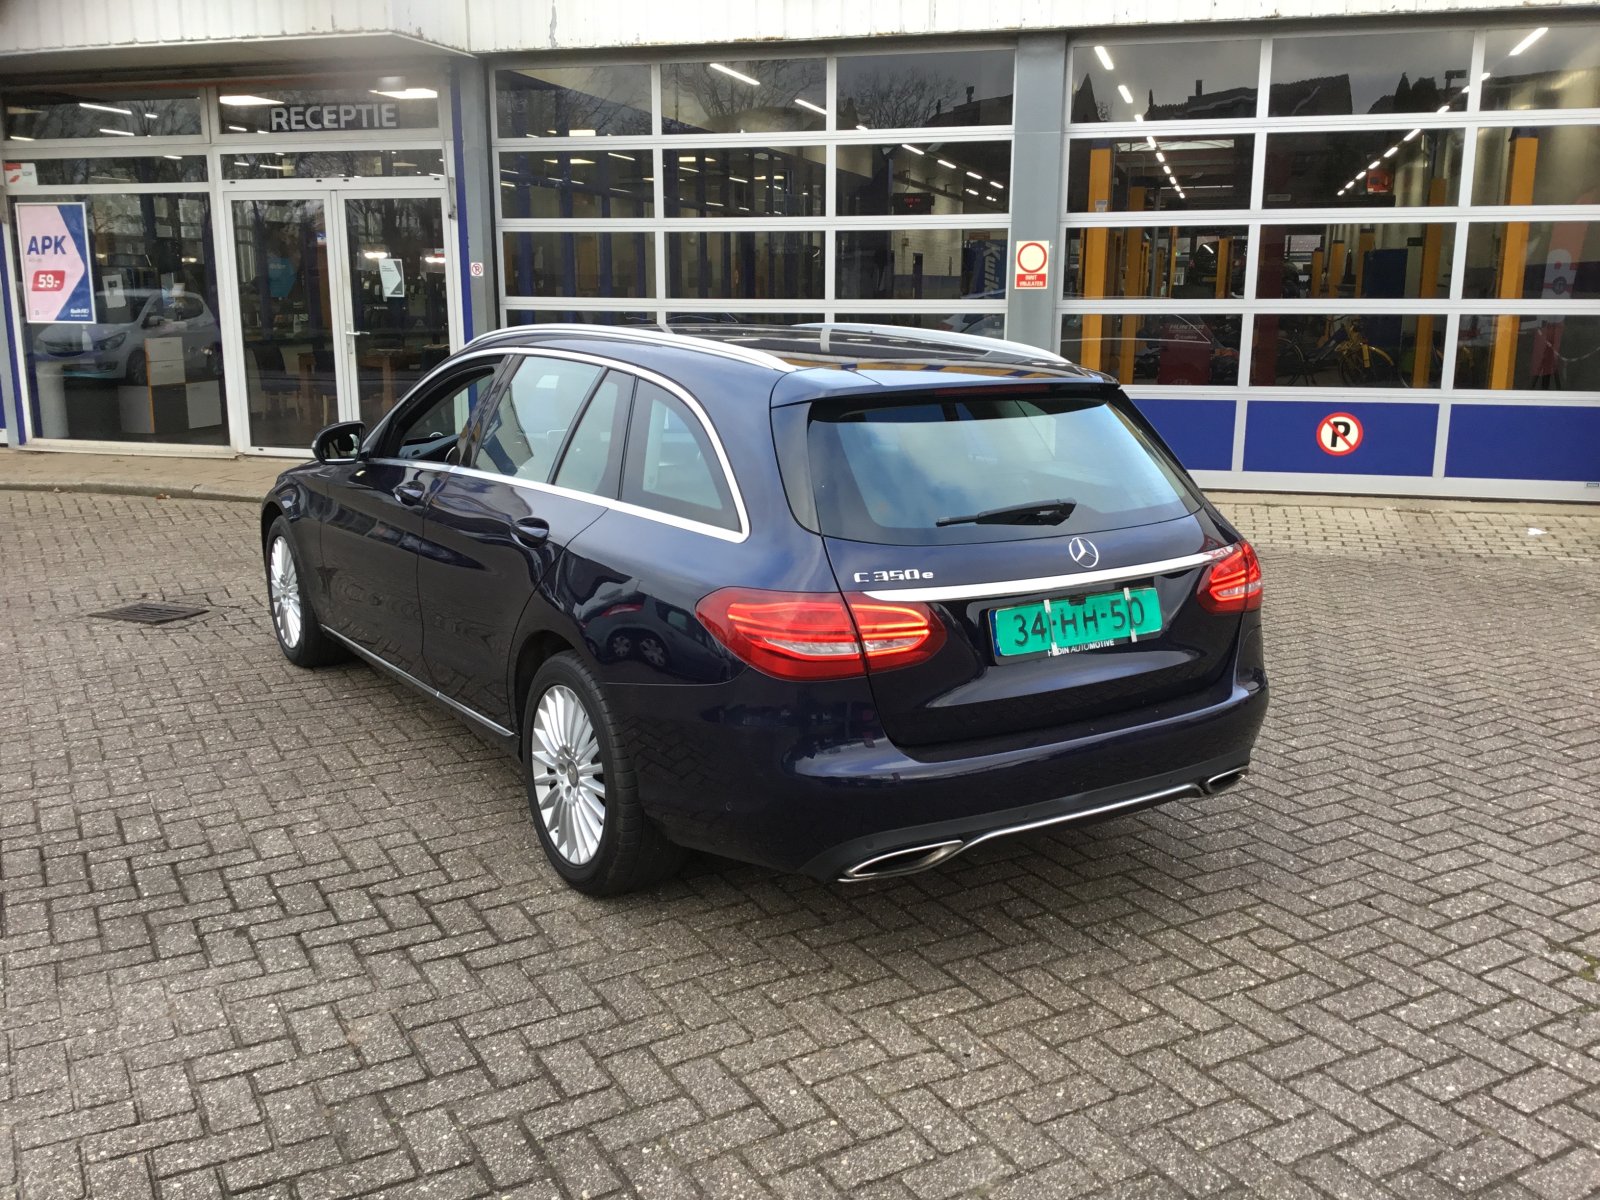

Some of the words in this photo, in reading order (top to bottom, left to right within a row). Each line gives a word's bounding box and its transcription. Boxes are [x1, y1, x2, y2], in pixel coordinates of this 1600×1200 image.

[270, 103, 397, 131] RECEPTIE
[27, 235, 67, 256] APK
[1013, 596, 1145, 647] 34-HH-50
[1047, 647, 1070, 657] HDIN
[1070, 638, 1115, 653] AUTOMOTIVE
